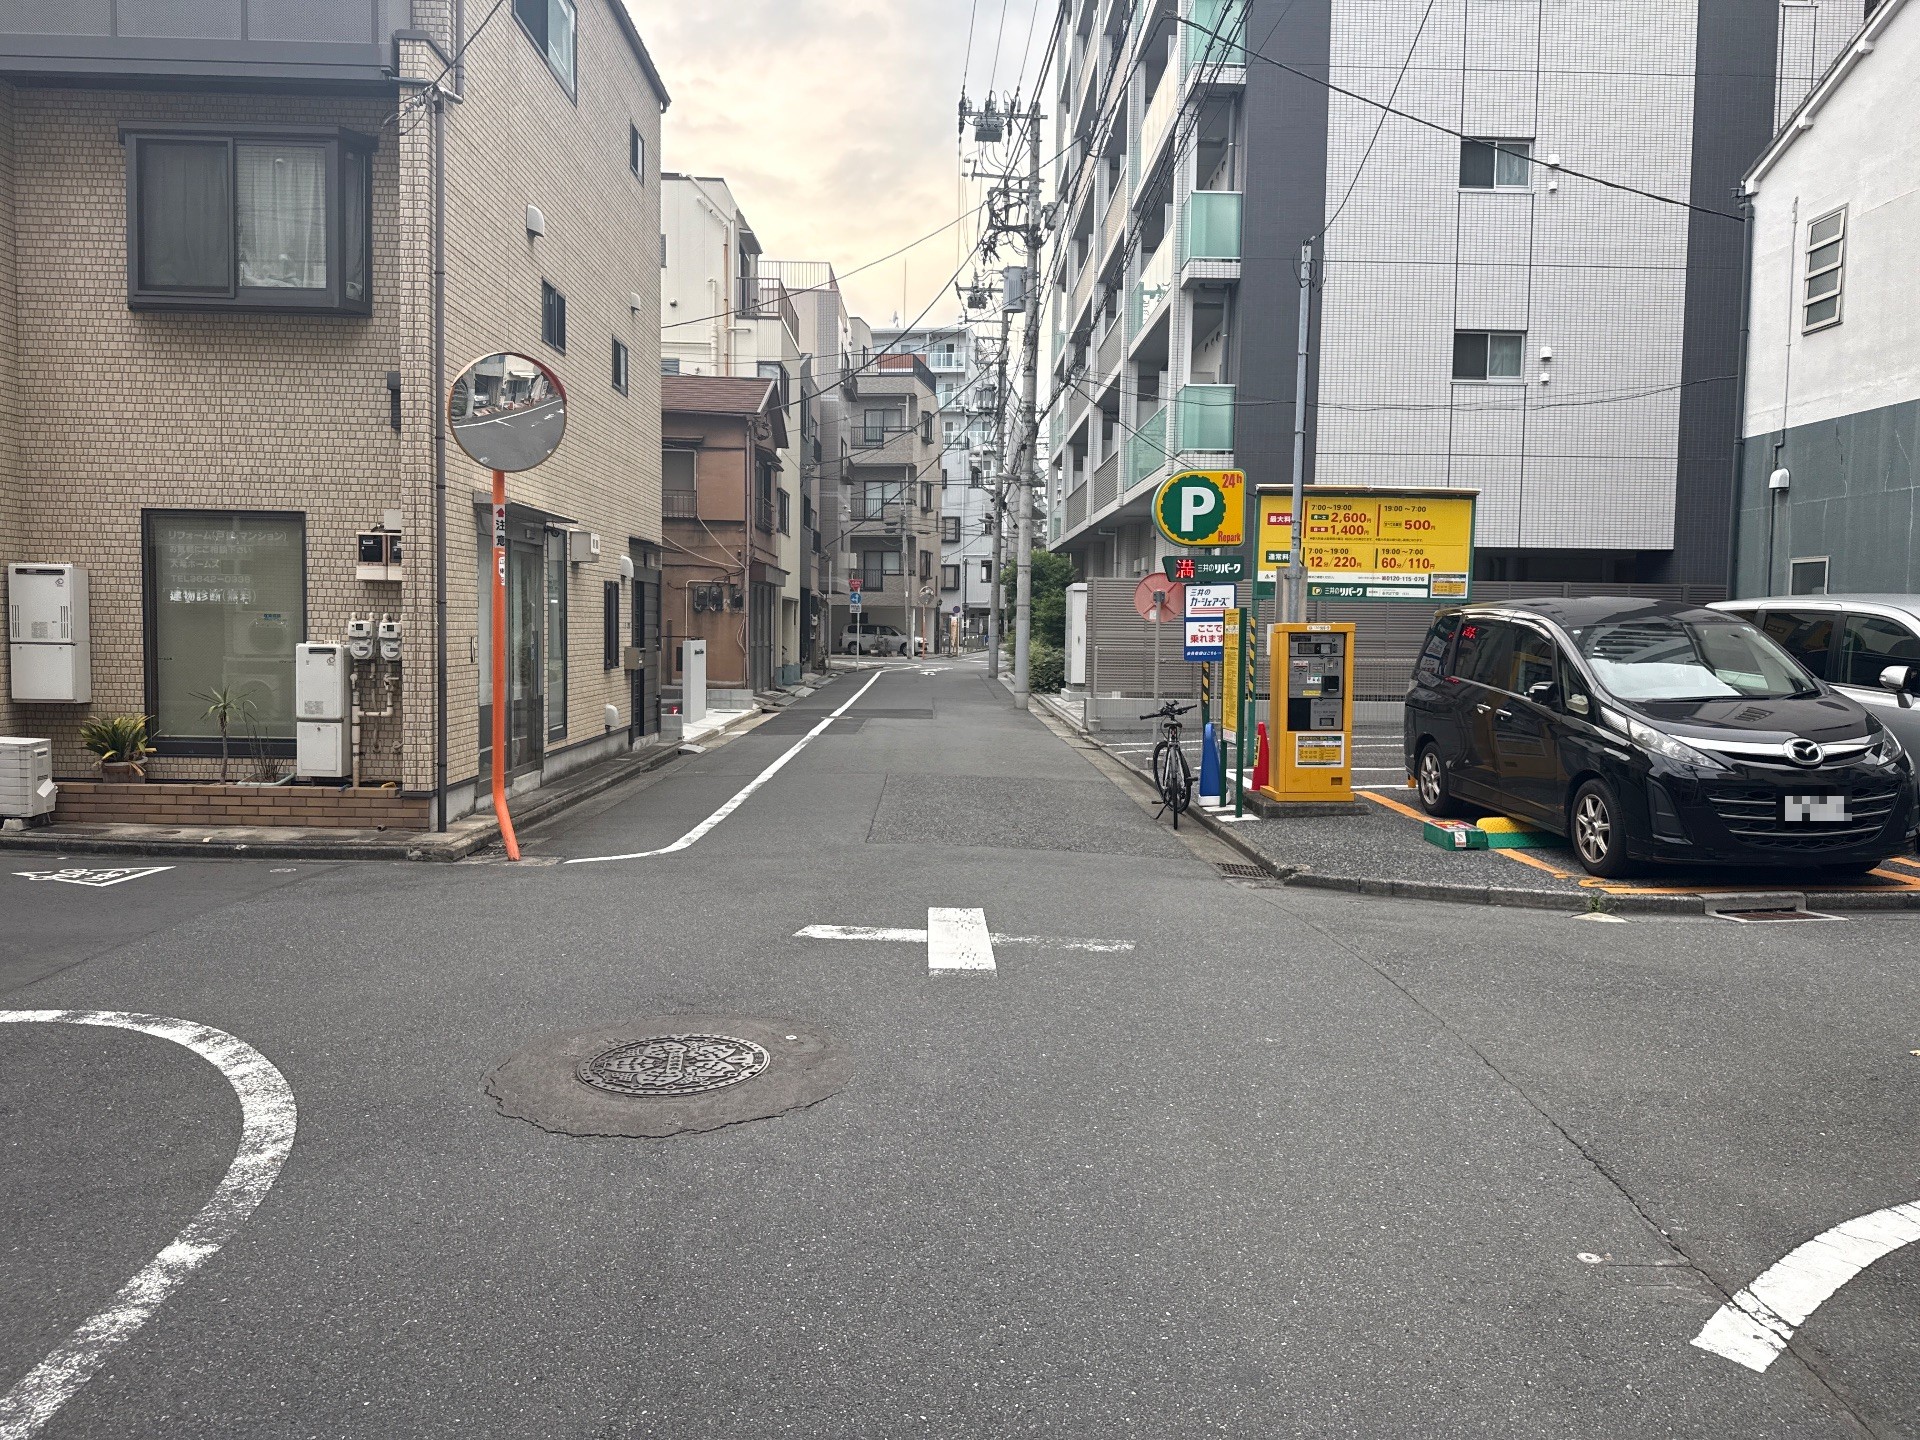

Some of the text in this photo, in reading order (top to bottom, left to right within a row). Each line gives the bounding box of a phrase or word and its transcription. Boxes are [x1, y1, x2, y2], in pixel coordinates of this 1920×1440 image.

[1222, 473, 1242, 488] 24h
[1181, 486, 1216, 532] P
[1269, 515, 1291, 523] 最大料
[1331, 512, 1371, 524] 2,600円
[1331, 524, 1369, 535] 1,400円
[1404, 520, 1436, 531] 500円
[495, 519, 505, 547] 注意
[1218, 531, 1241, 543] Repark
[1268, 553, 1291, 561] 通常料
[1176, 559, 1195, 578] 満
[1197, 563, 1241, 574] 三井のリパーク
[1190, 588, 1211, 597] 三井の
[1324, 586, 1363, 596] 三井のリパーク
[1190, 597, 1228, 607] カーシェアーズ
[1198, 625, 1223, 633] ここで
[1190, 634, 1223, 643] 乗れます
